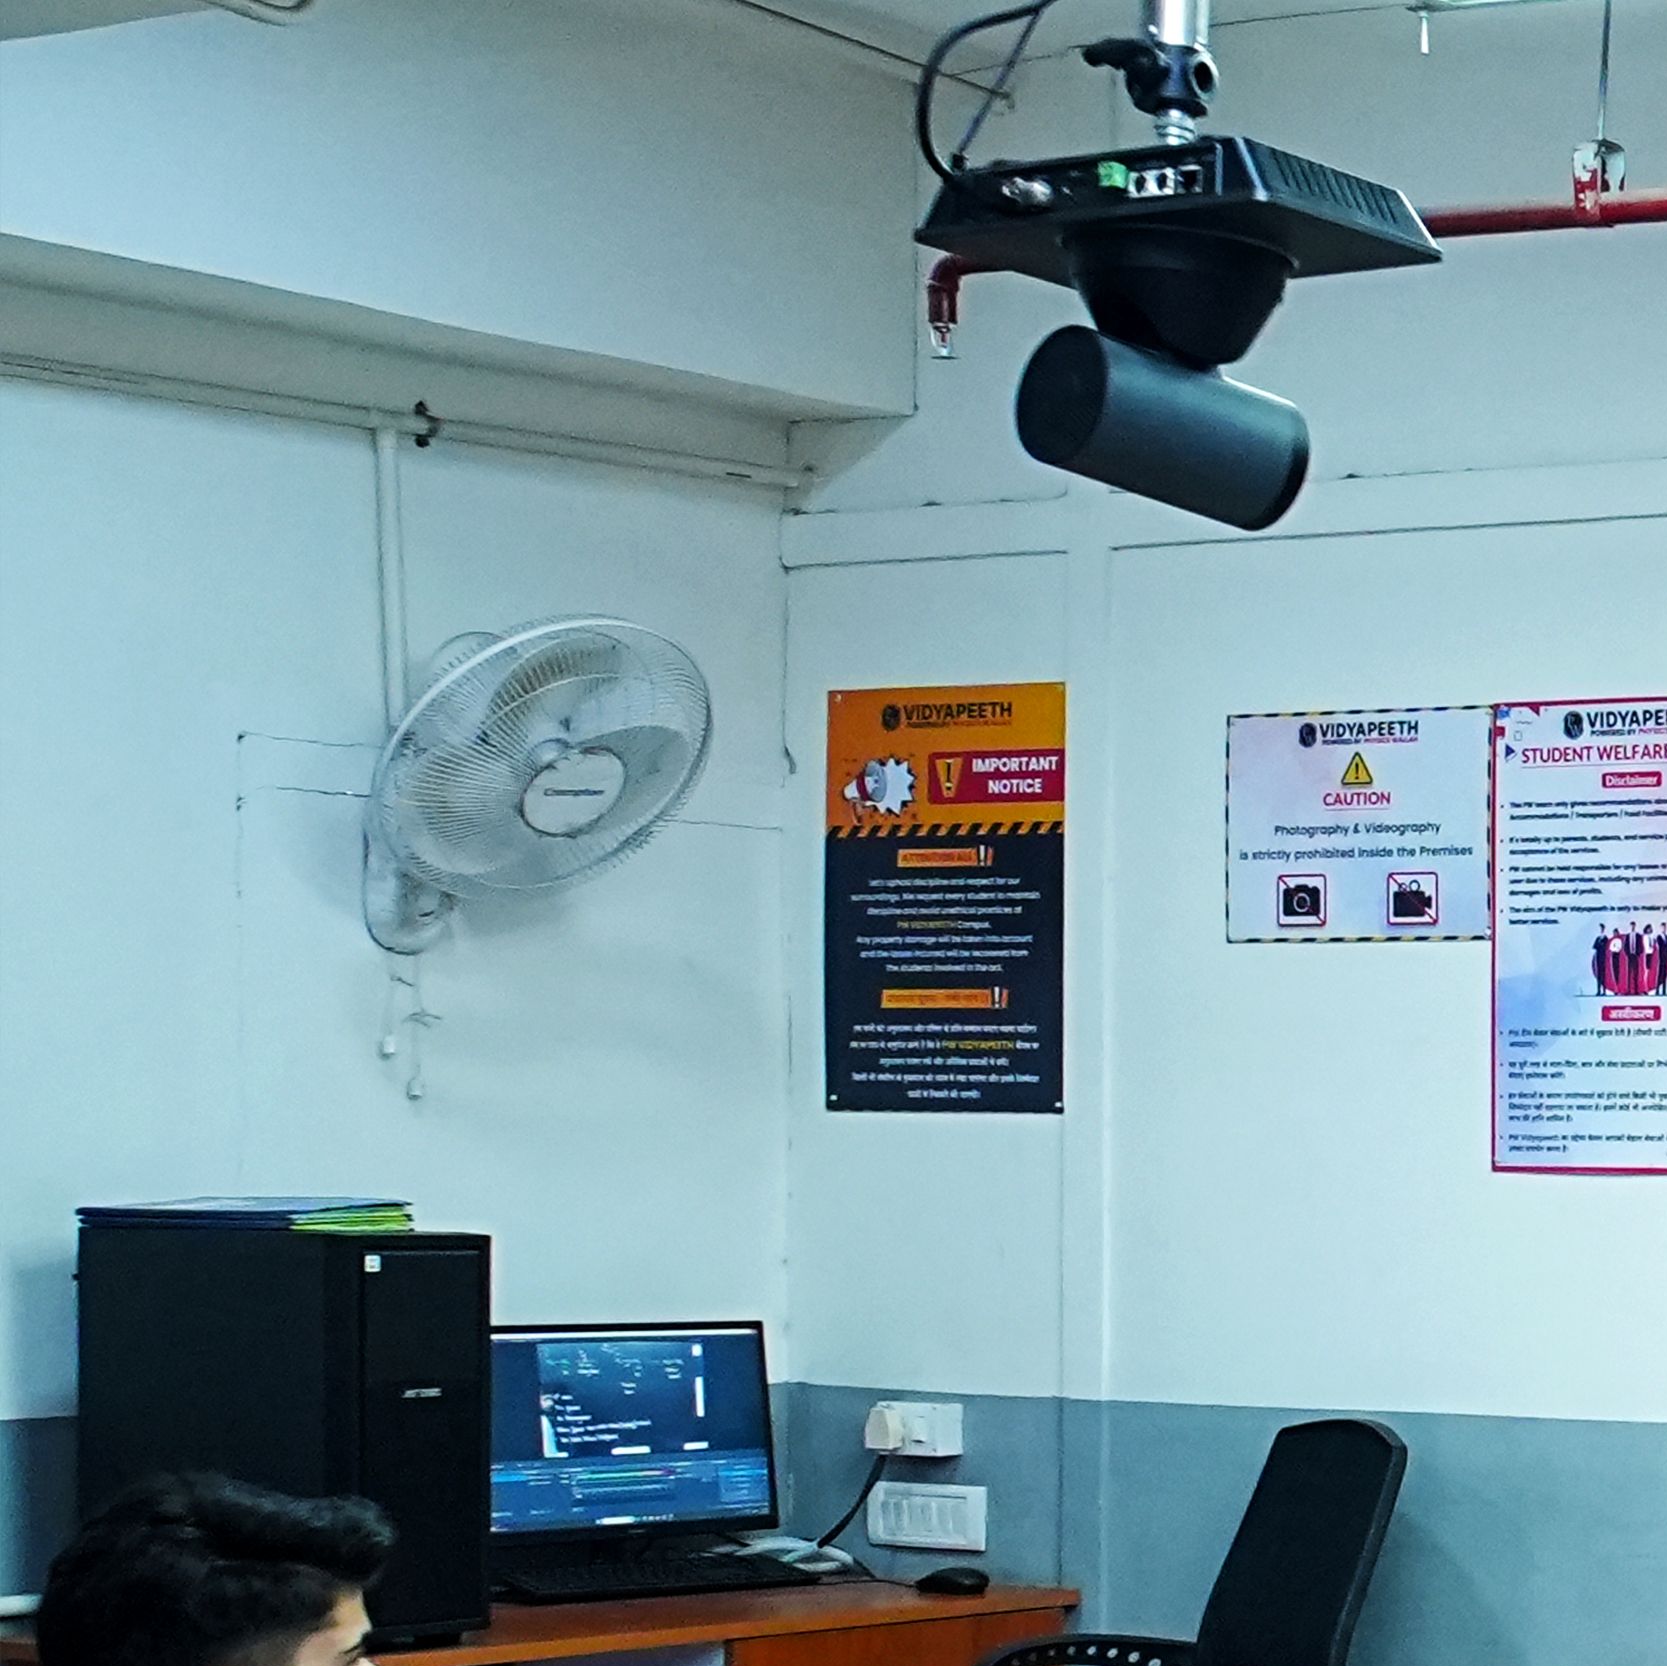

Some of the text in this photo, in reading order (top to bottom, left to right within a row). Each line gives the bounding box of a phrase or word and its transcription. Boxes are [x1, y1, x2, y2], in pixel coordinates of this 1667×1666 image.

[904, 702, 1012, 720] VIDYAPEETH
[1319, 720, 1418, 738] VIDYAPEETH
[1522, 746, 1594, 763] STUDENT
[972, 756, 1058, 772] IMPORTANT
[988, 779, 1042, 794] NOTICE
[1605, 774, 1659, 787] Disclaimer
[1323, 792, 1391, 806] CAUTION
[1274, 822, 1441, 838] Photography & Videography
[1240, 849, 1248, 860] is
[1252, 848, 1290, 862] strictly
[1294, 848, 1354, 862] prohibited
[1397, 846, 1416, 857] the
[1420, 845, 1473, 857] Premises
